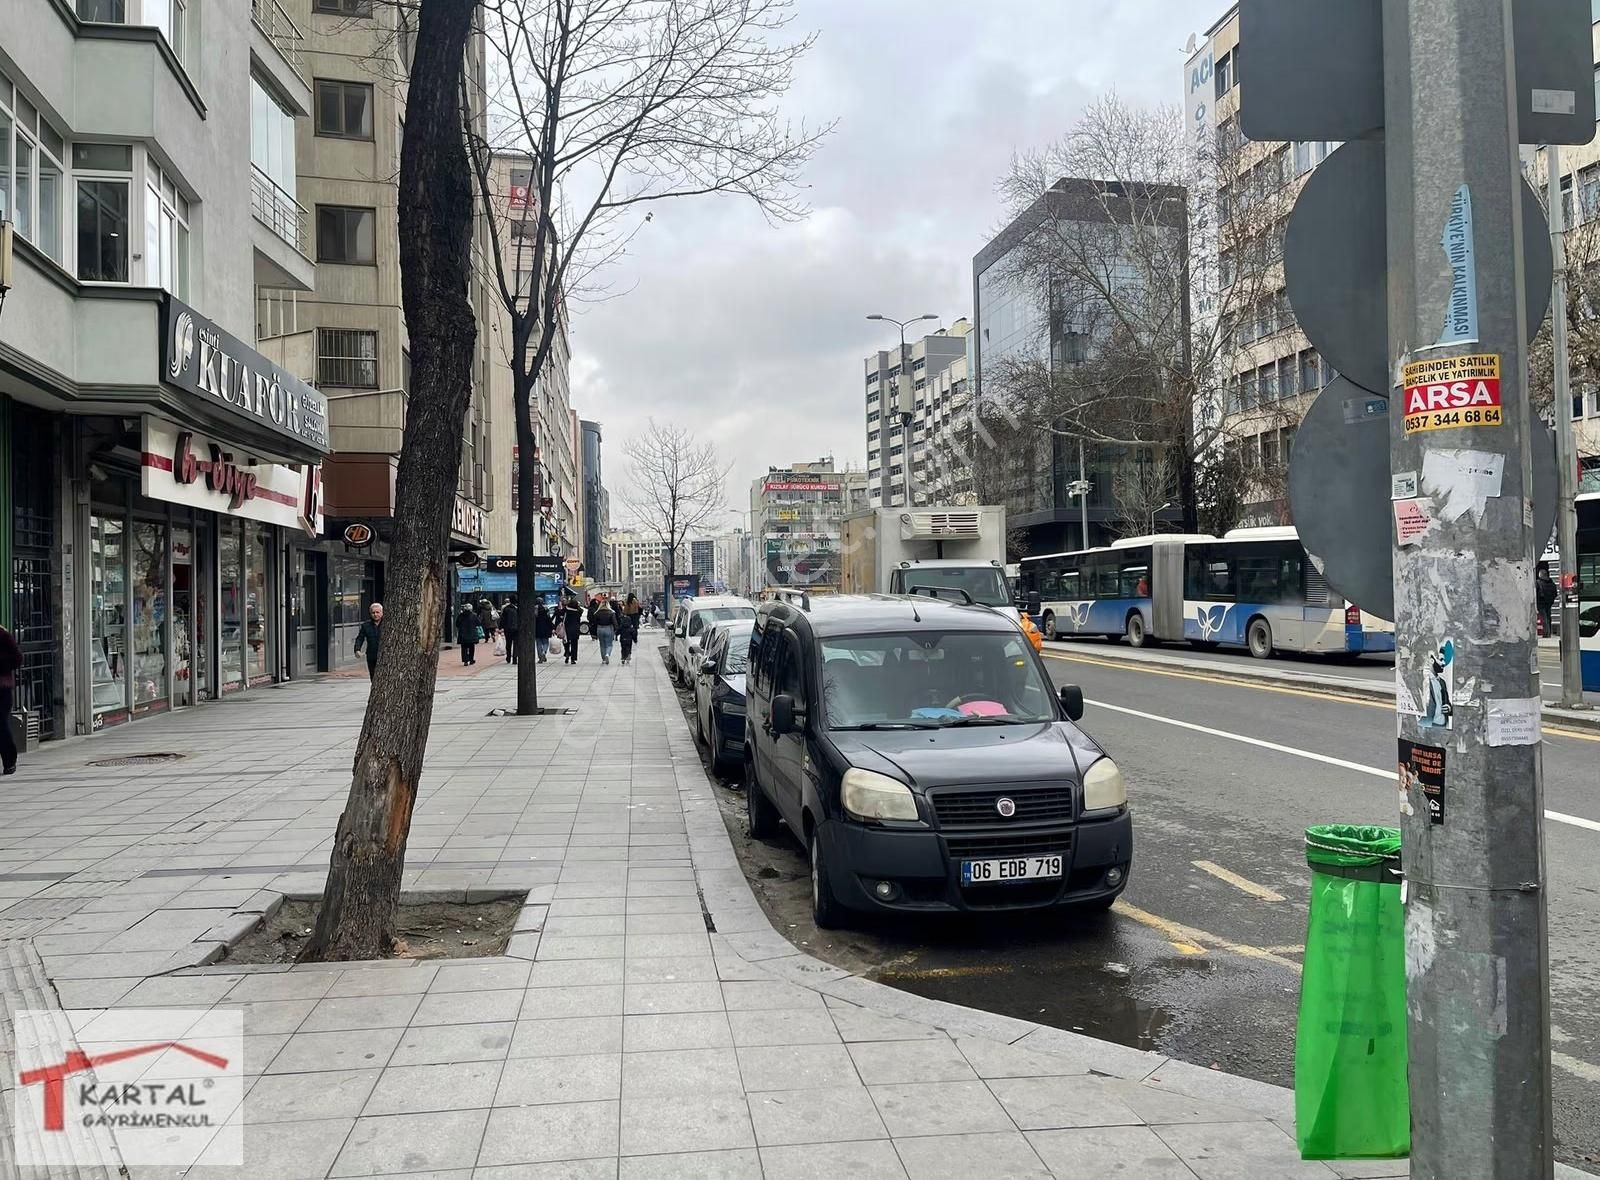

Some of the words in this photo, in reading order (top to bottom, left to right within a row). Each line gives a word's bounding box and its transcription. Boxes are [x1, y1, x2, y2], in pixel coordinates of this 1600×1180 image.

[1191, 52, 1214, 95] ACI
[1452, 266, 1469, 336] KALKINMASI
[198, 327, 220, 349] esinti
[1459, 356, 1496, 368] SATILIK
[1438, 371, 1450, 381] VE
[1452, 368, 1496, 379] YATIRIMLIK
[197, 338, 300, 434] KUAFÖR
[1409, 381, 1493, 413] ARSA
[1405, 415, 1429, 431] 0537
[1434, 412, 1460, 426] 344
[1464, 410, 1481, 423] 68
[1484, 409, 1500, 422] 64
[972, 862, 992, 879] 06
[999, 860, 1027, 878] EDB
[1035, 857, 1060, 875] 719
